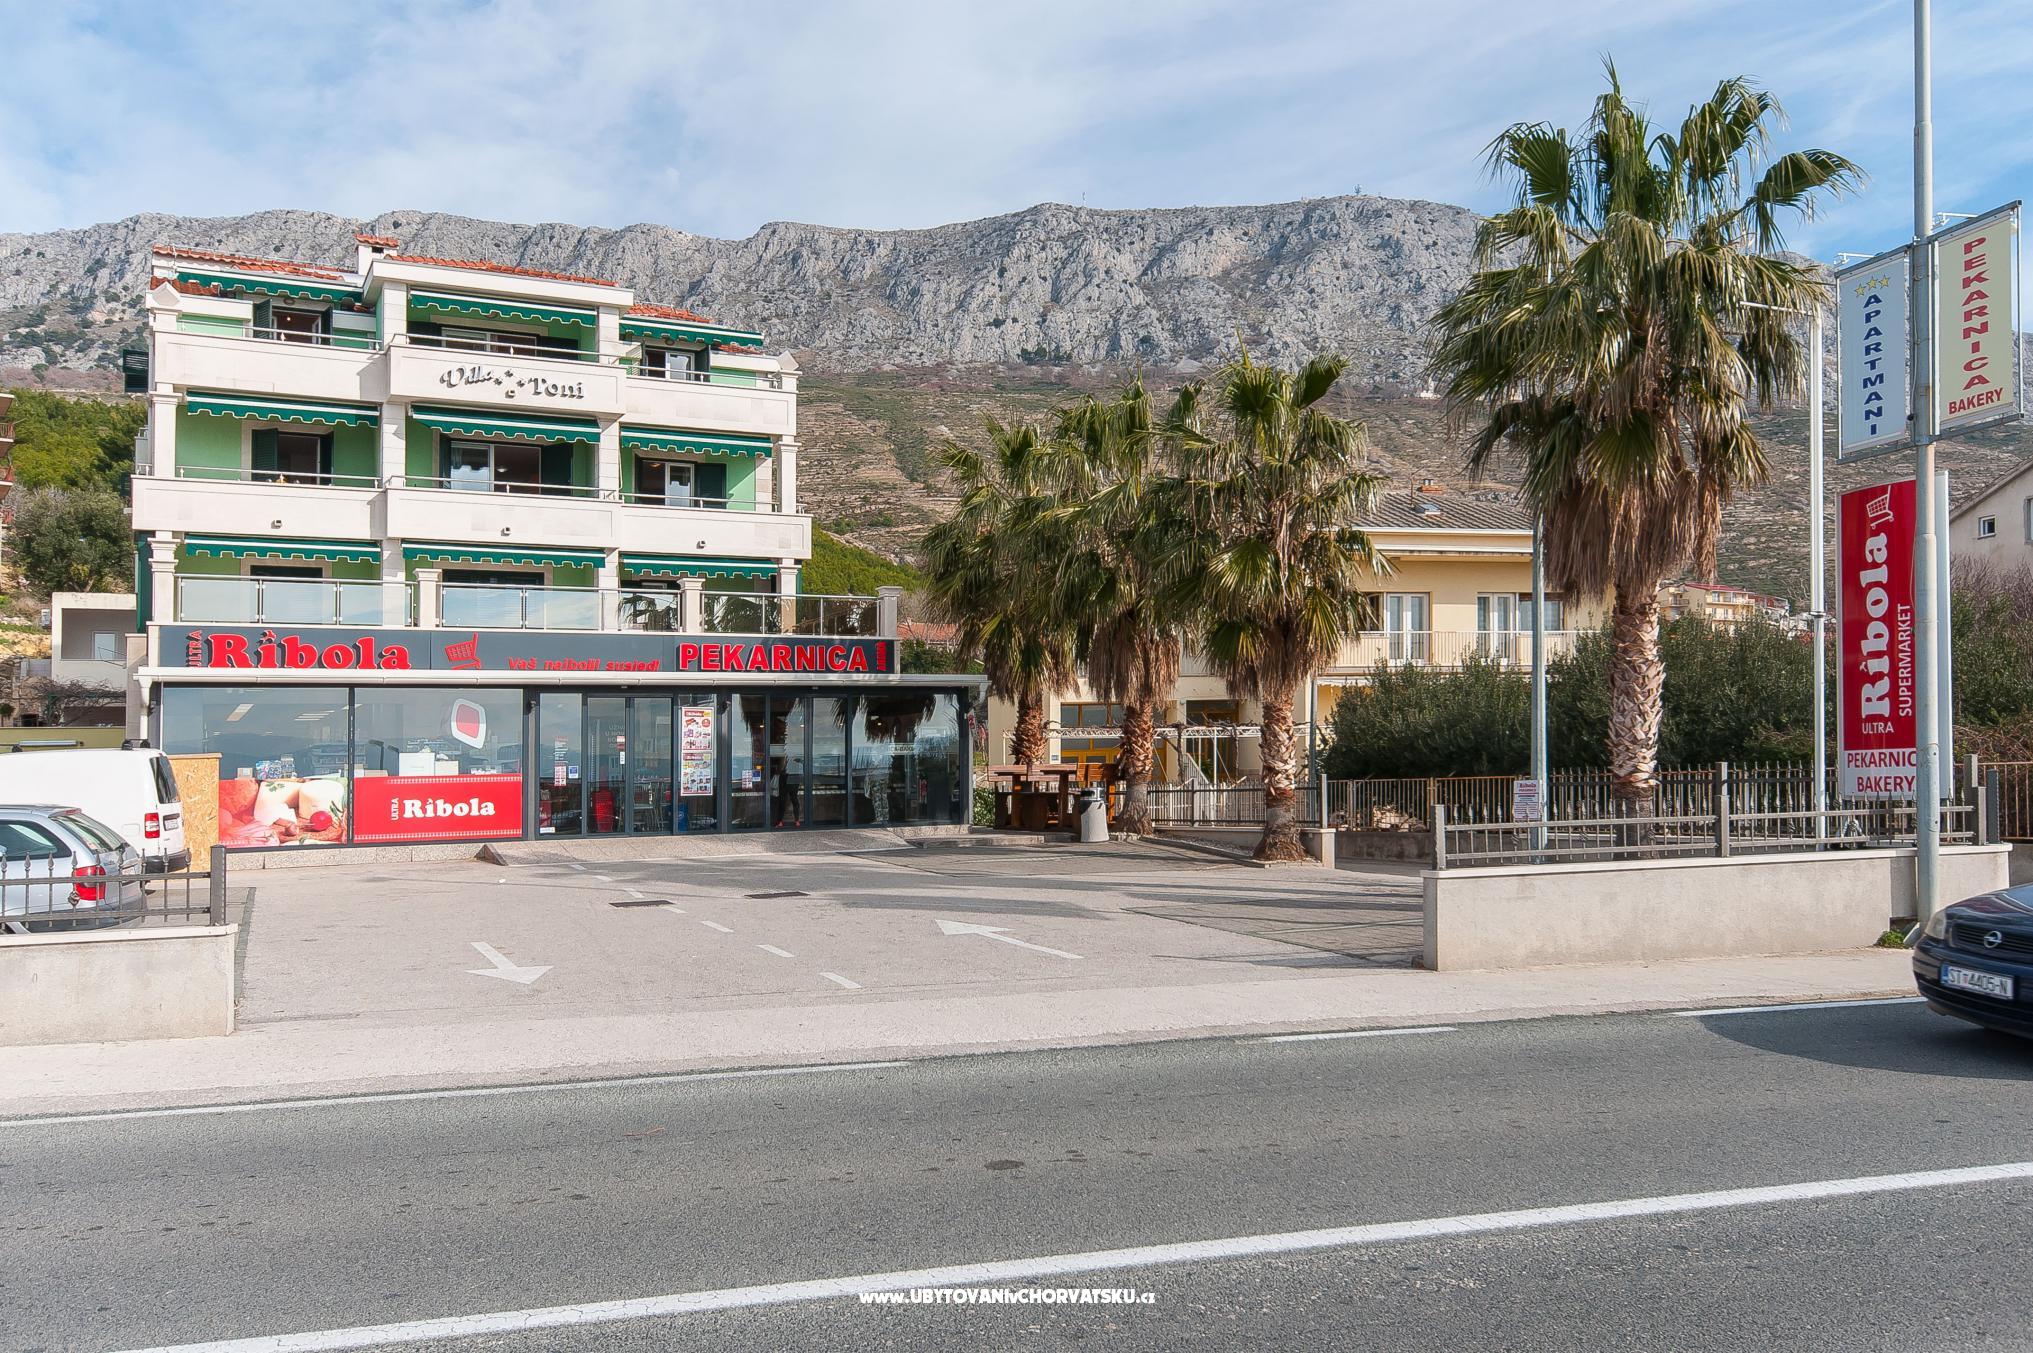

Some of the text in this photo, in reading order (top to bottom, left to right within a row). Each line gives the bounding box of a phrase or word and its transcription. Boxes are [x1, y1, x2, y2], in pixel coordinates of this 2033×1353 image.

[1962, 237, 1989, 391] PEKARNICA
[1863, 293, 1884, 436] APARTMANI
[527, 376, 584, 399] Toni
[1949, 387, 2003, 415] BAKERY
[1860, 532, 1891, 718] Ribola
[206, 629, 412, 670] Ribola
[679, 642, 870, 672] PEKARNICA
[1897, 603, 1913, 717] SUPERMARKET
[508, 657, 537, 671] Vaš
[1861, 721, 1895, 734] ULTRA
[1847, 750, 1917, 768] PEKARNIC
[1857, 775, 1916, 792] BAKERY
[402, 797, 496, 819] Ribola
